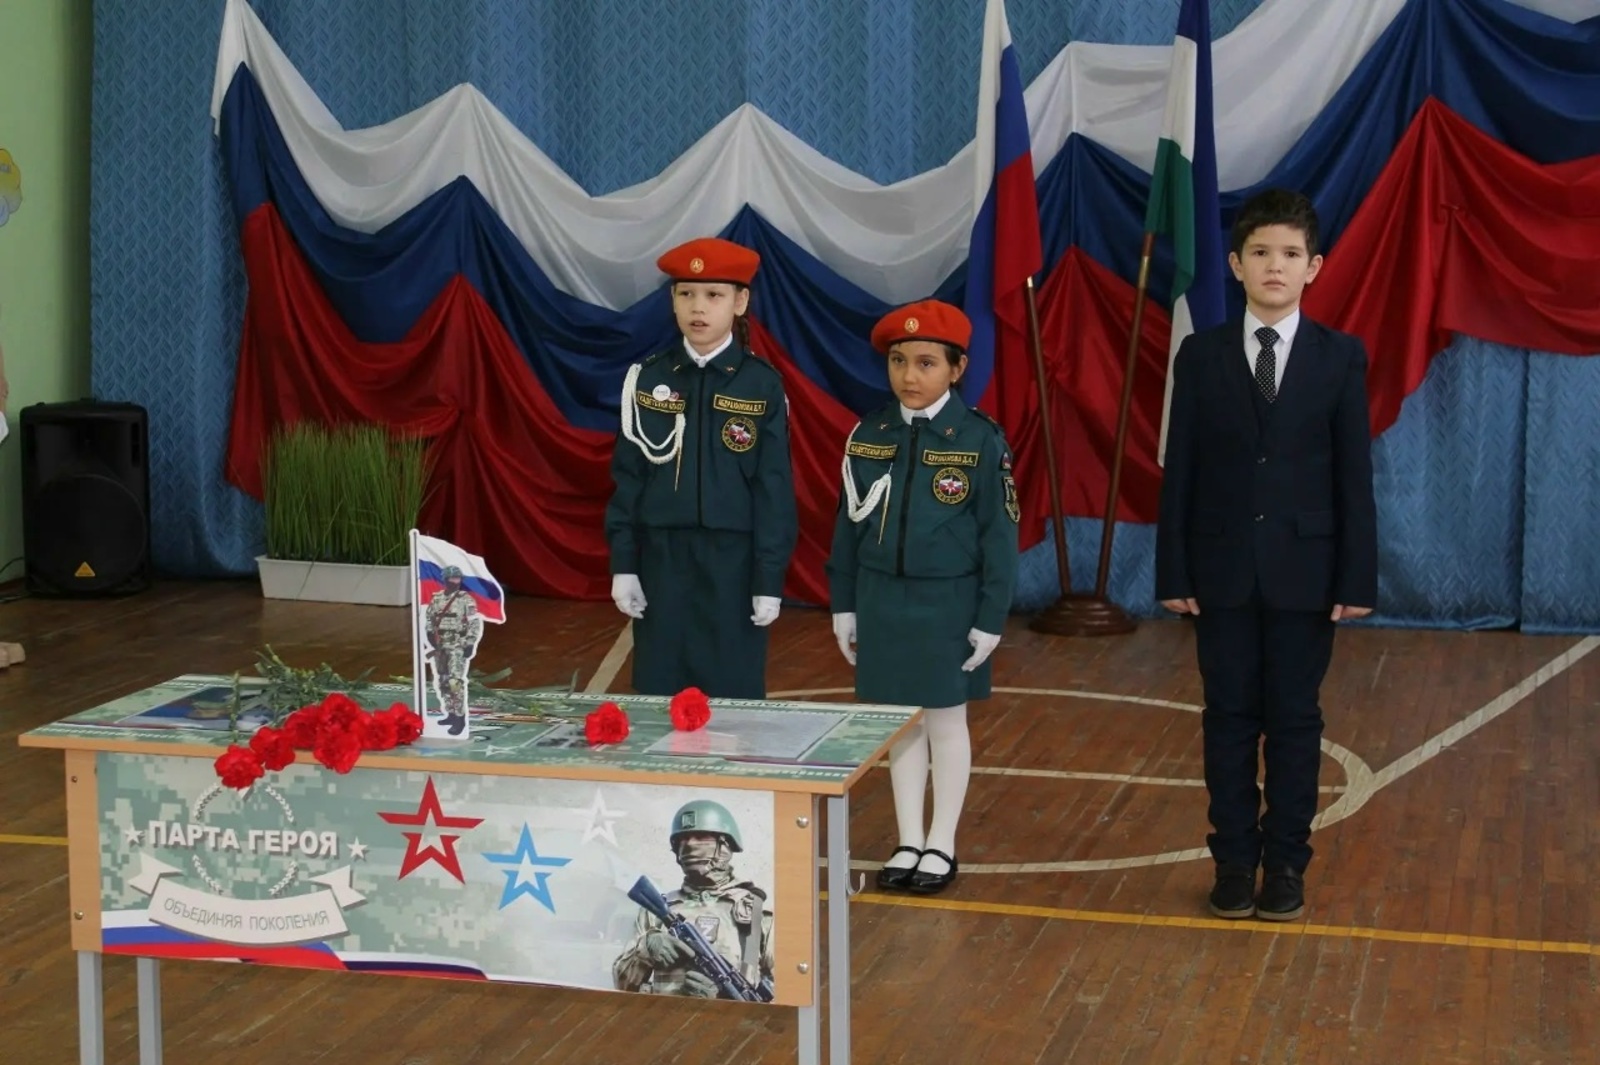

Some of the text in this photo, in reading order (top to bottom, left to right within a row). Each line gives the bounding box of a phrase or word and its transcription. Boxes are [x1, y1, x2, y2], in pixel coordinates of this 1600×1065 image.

[149, 820, 338, 857] ПАРТА ГЕРОЯ
[164, 898, 330, 931] ОБЪЕДИНЯЯ ПОКОЛЕНИЯ
